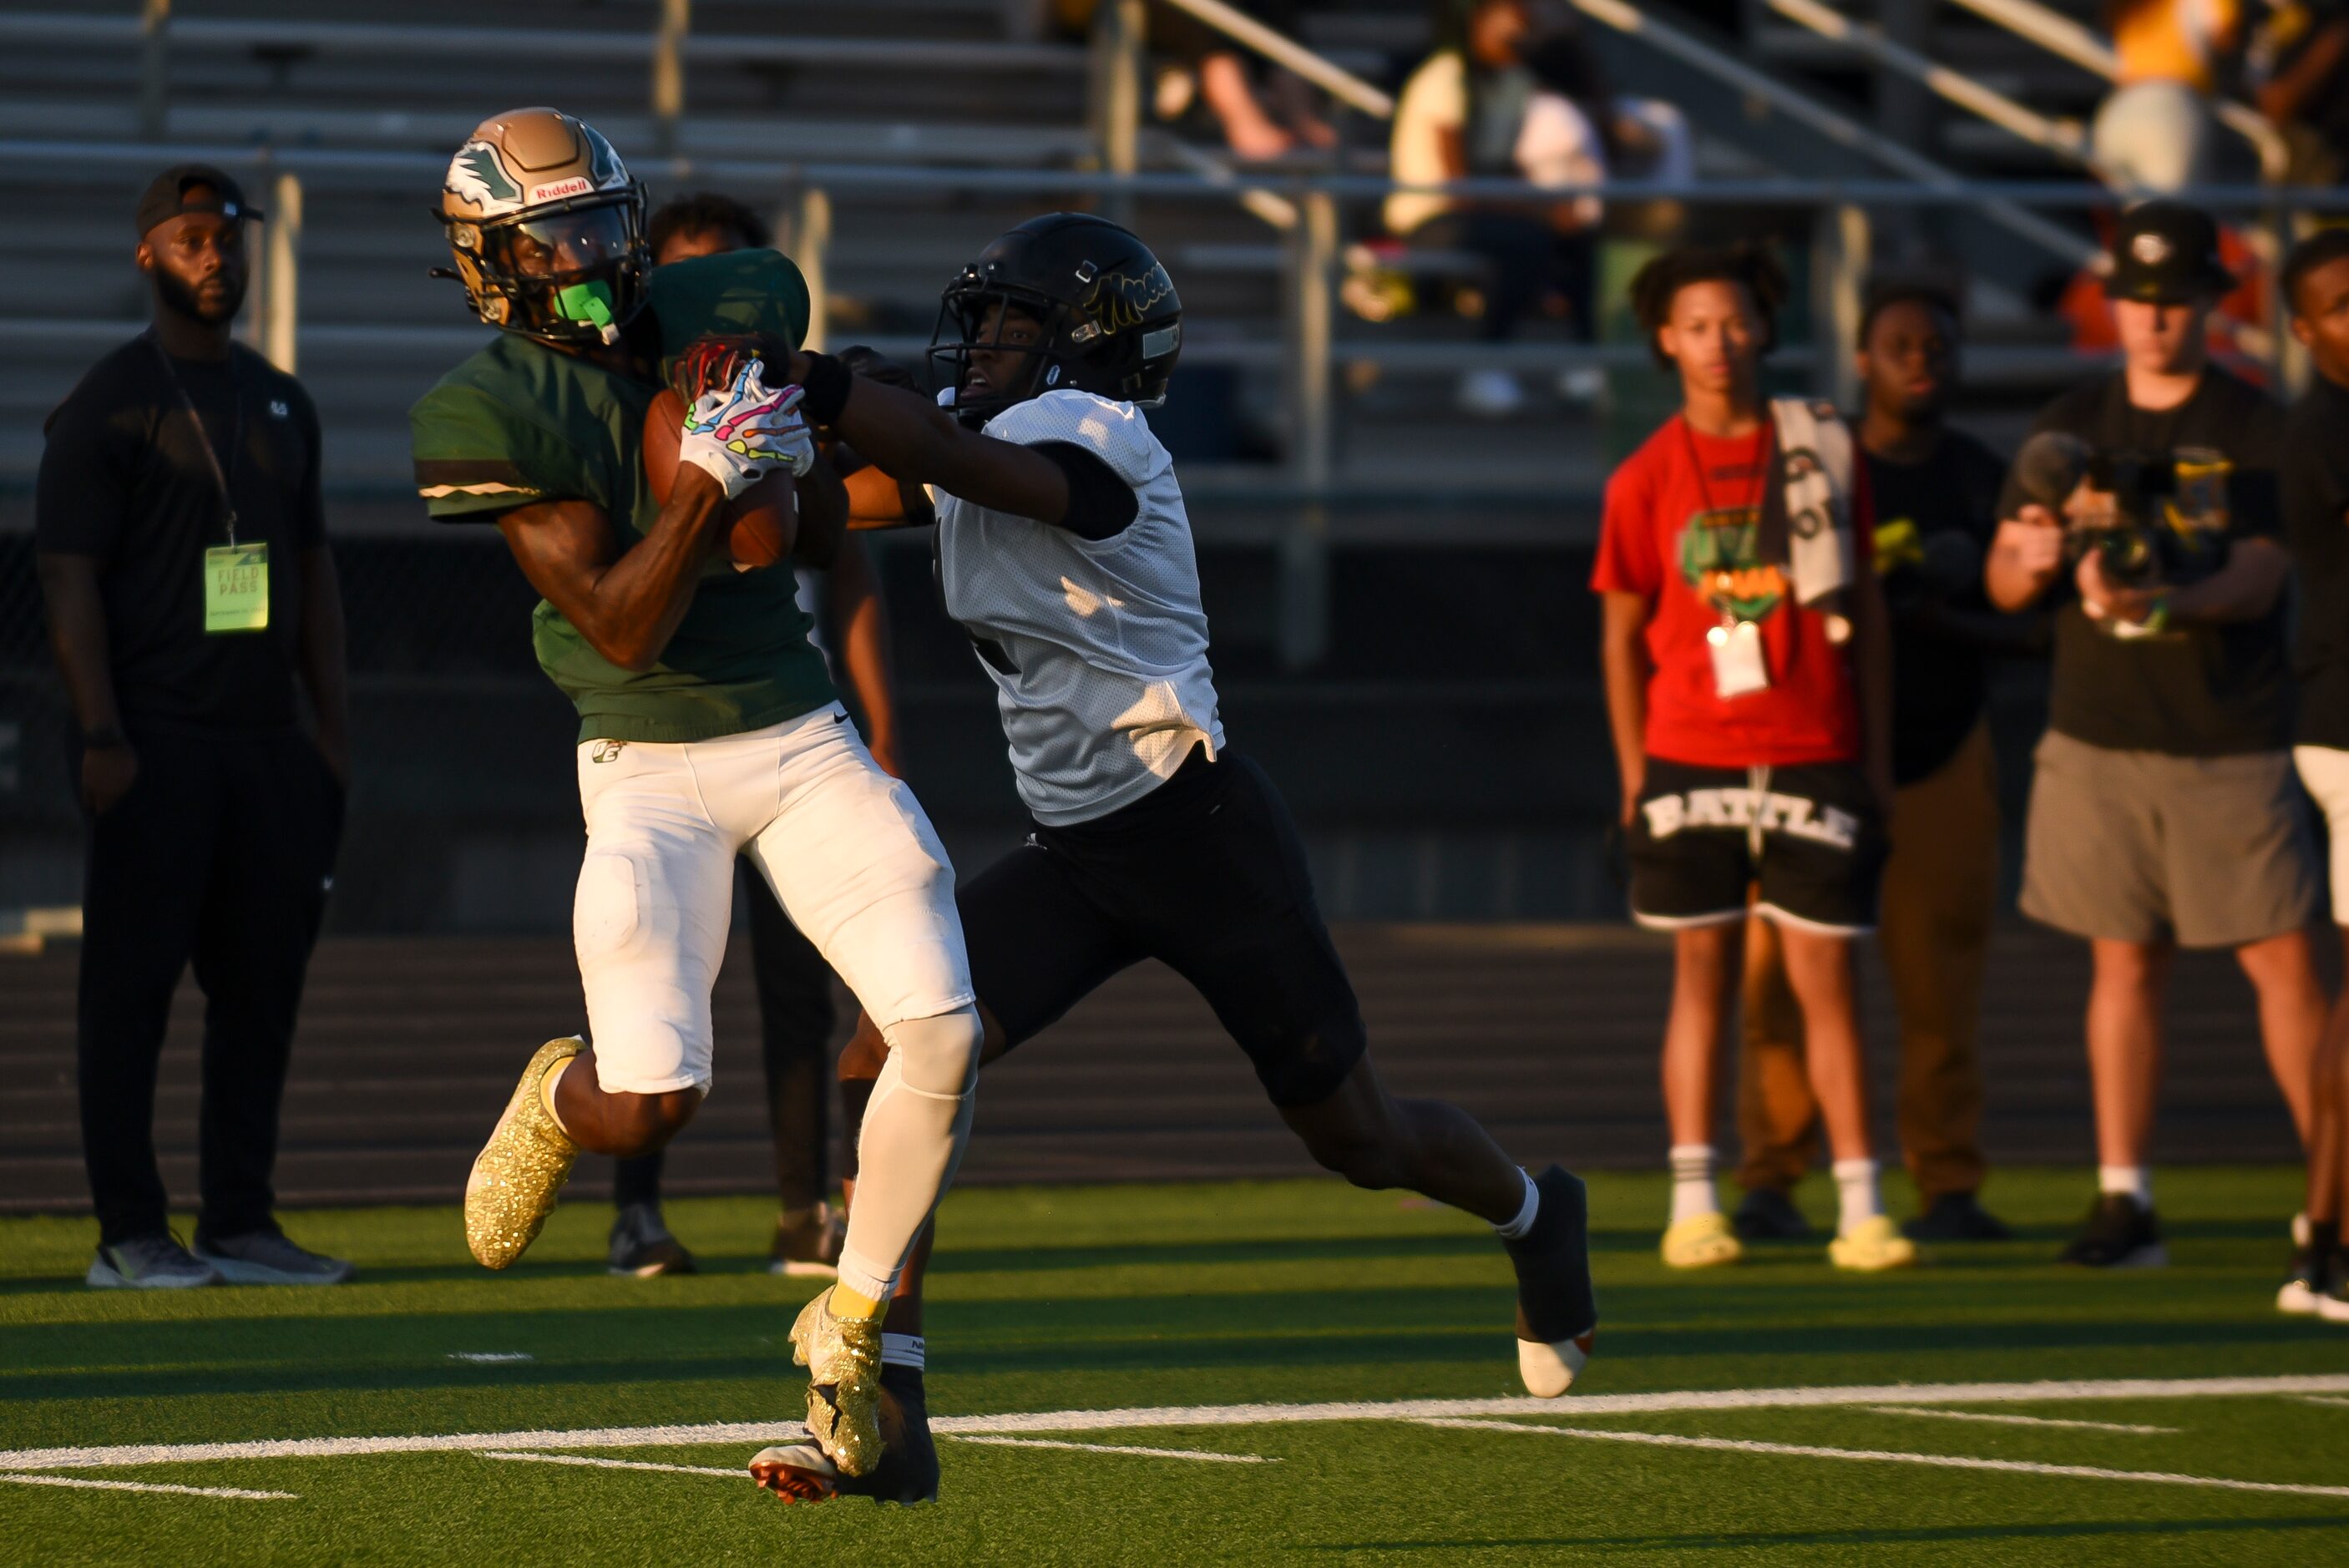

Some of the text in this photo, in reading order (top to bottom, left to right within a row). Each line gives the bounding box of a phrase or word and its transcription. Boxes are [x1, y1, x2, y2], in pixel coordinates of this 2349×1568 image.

[536, 178, 587, 200] Riddell
[218, 566, 260, 583] FIELD
[220, 579, 259, 595] PASS
[1643, 787, 1858, 850] BATTLE
